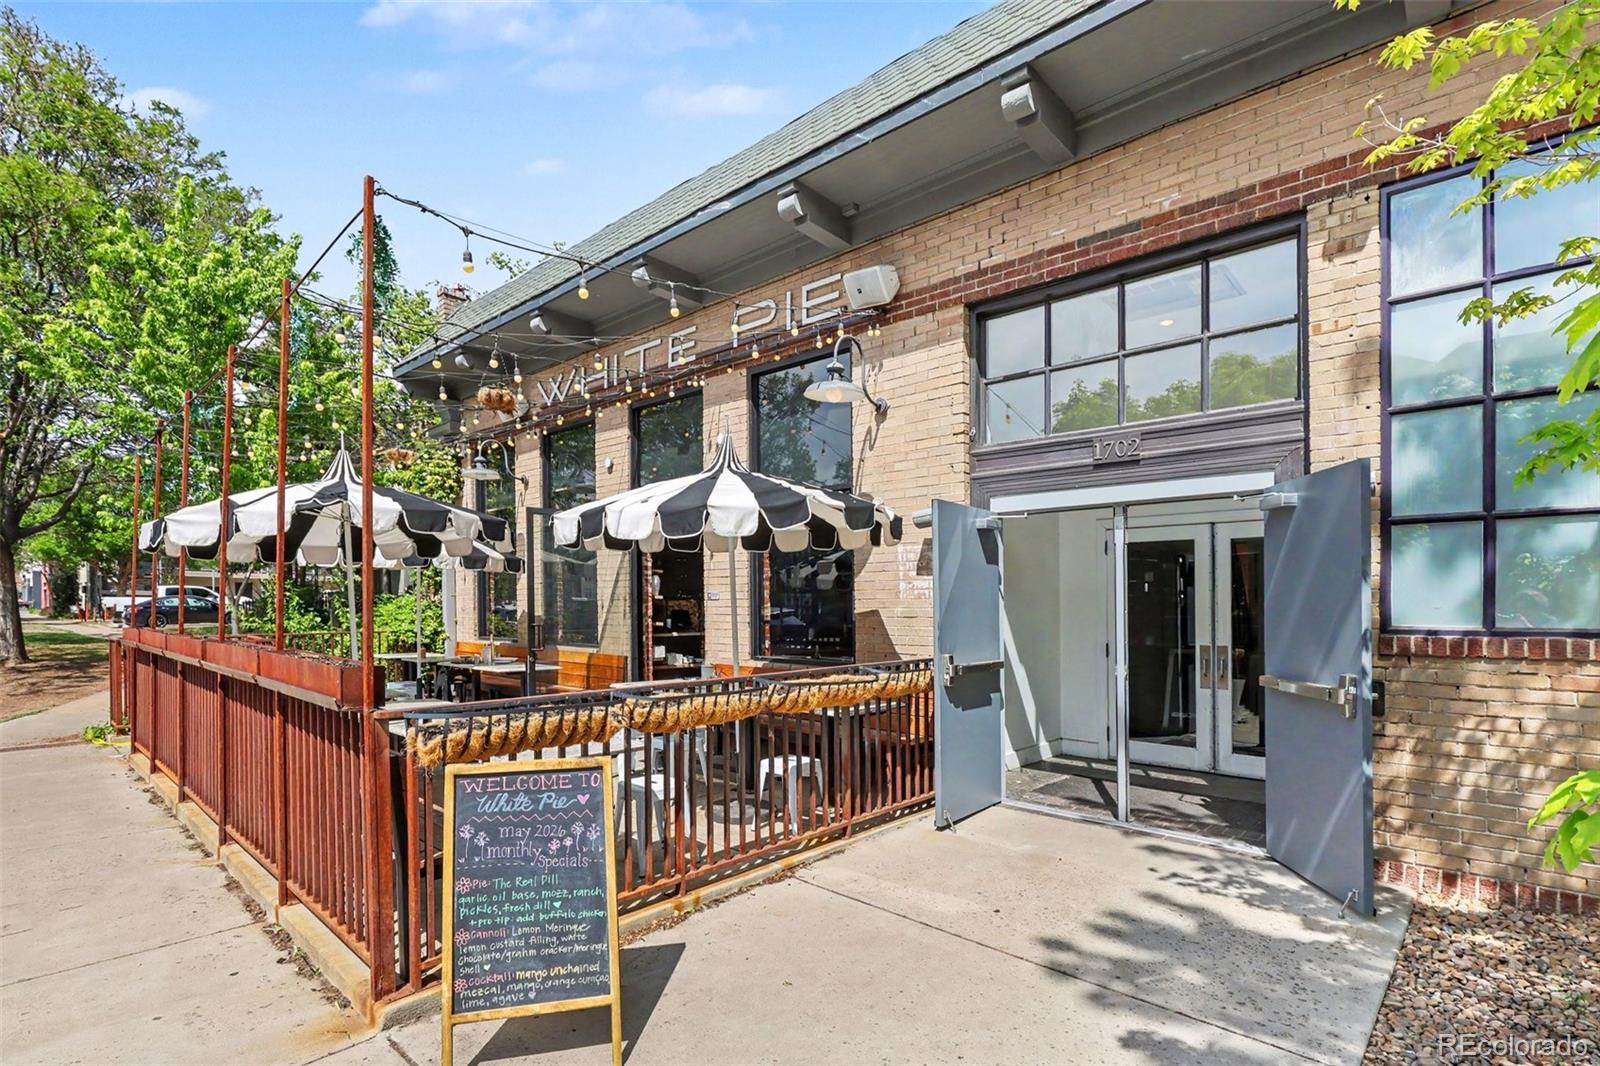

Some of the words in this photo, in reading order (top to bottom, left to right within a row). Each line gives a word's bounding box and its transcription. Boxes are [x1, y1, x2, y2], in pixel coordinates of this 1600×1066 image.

[537, 325, 697, 406] WHITE
[732, 273, 842, 348] PIE
[1093, 438, 1140, 460] 1702
[460, 774, 572, 793] WELCOME
[579, 772, 601, 787] TO
[476, 791, 534, 813] White
[537, 791, 577, 811] Pie
[534, 824, 566, 838] 2026
[486, 841, 542, 866] monthly
[493, 877, 512, 889] The
[515, 876, 538, 888] Real
[541, 873, 559, 886] Dill
[458, 893, 488, 909] garlic
[492, 891, 506, 902] oil
[511, 890, 539, 901] base,
[573, 886, 605, 899] ranch,
[502, 902, 532, 913] fresh
[533, 900, 551, 911] dill
[516, 912, 535, 923] add
[539, 908, 577, 921] buffalo
[515, 968, 548, 983] mango
[549, 960, 601, 977] unchained
[491, 992, 525, 1007] agave
